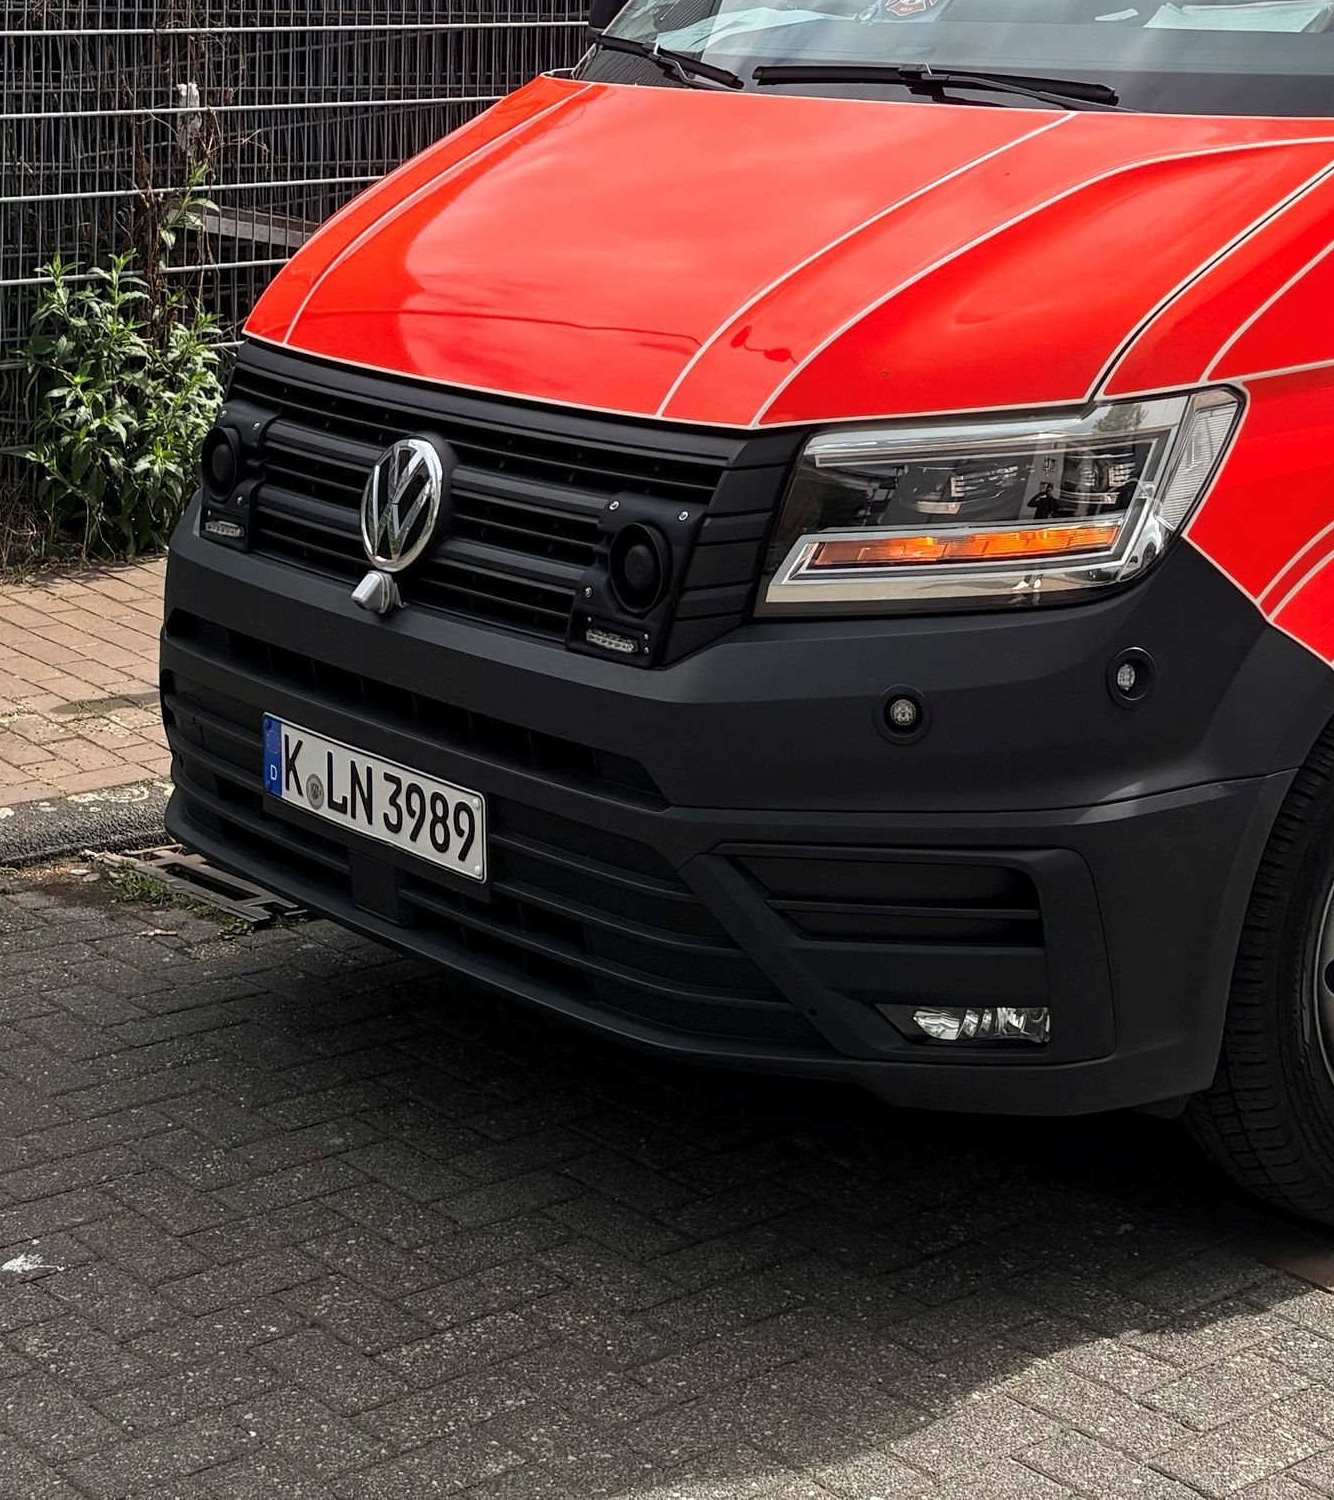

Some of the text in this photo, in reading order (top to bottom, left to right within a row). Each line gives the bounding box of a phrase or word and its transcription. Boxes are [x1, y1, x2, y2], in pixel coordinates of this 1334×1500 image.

[270, 764, 278, 781] D
[284, 733, 304, 797] K
[327, 750, 373, 826] LN
[383, 772, 476, 862] 3989
